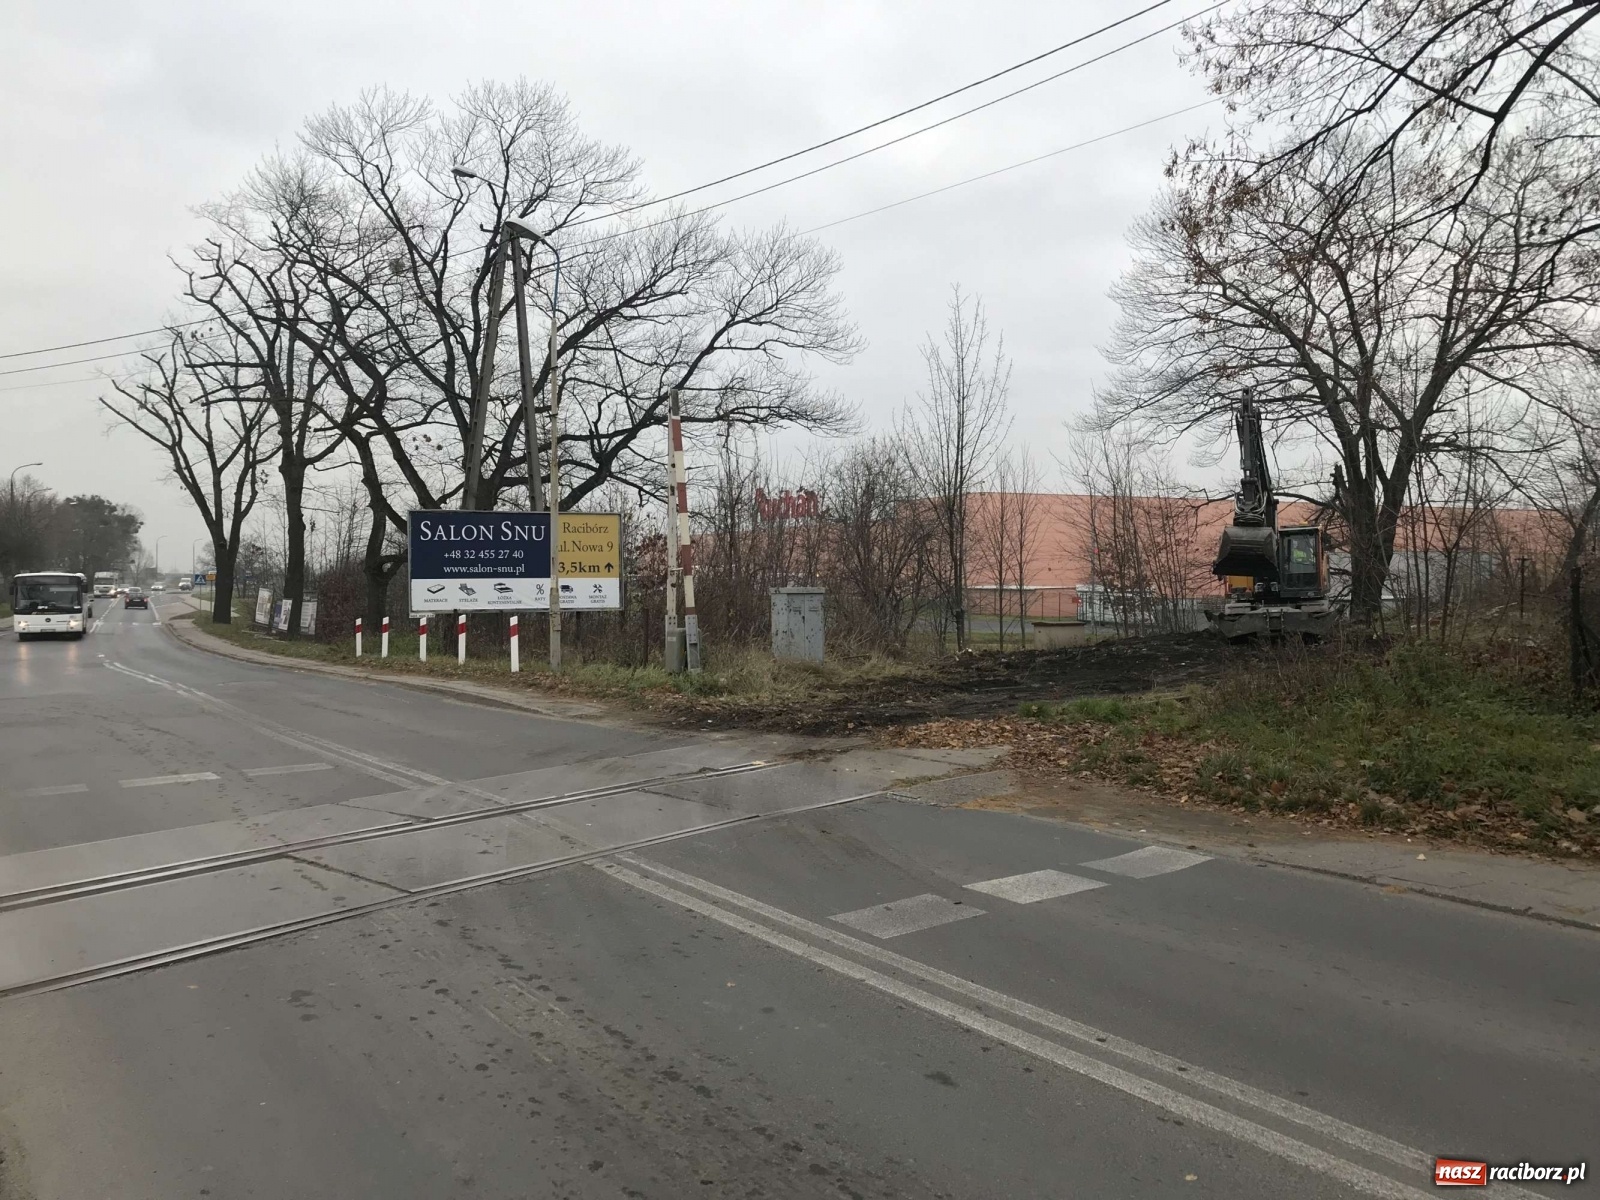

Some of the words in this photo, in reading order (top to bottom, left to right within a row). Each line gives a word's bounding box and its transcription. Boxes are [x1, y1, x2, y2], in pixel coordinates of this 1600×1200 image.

[562, 522, 609, 534] Racibórz
[572, 540, 603, 553] Nowa
[606, 541, 614, 553] 9
[443, 550, 461, 559] +48
[463, 550, 476, 559] 32
[478, 550, 495, 559] 455
[497, 550, 509, 559] 27
[512, 550, 524, 559] 40
[443, 564, 525, 575] www.salon-snu.pl
[558, 561, 601, 575] 3,5km
